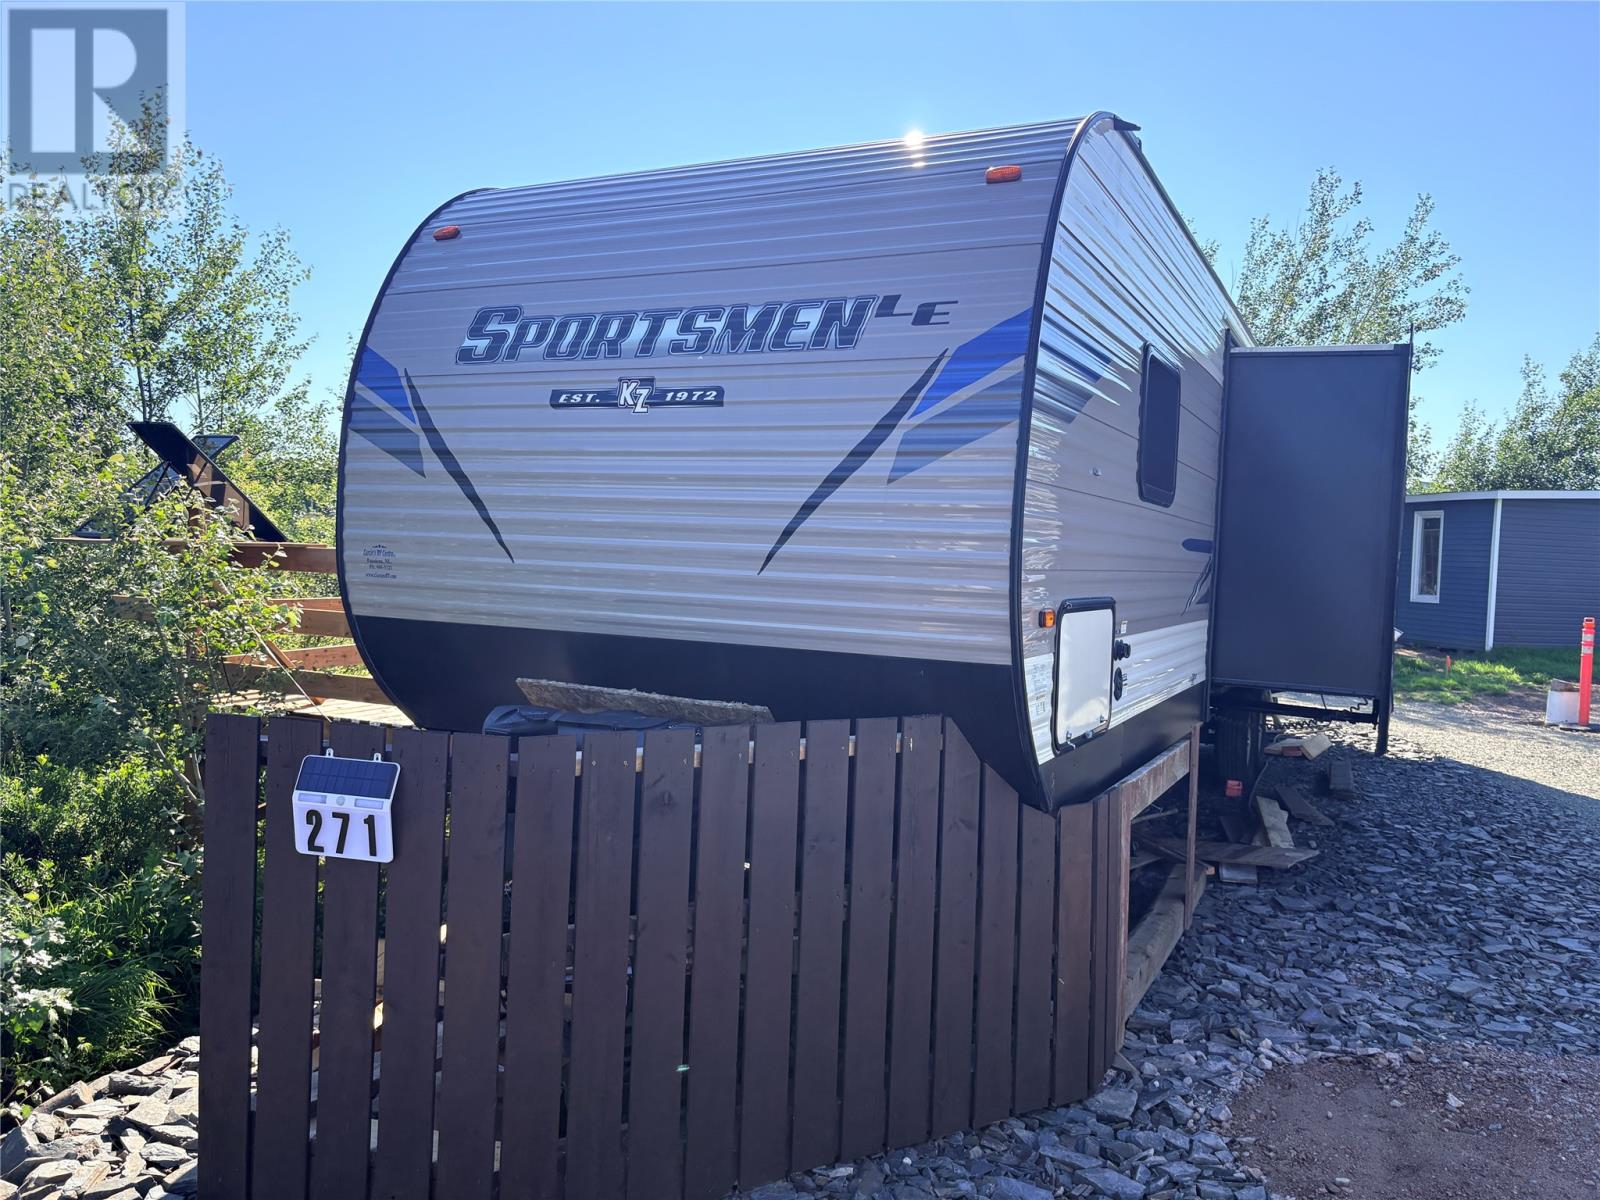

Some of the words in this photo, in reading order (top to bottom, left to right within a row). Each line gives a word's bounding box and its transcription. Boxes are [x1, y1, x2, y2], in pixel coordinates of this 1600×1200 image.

[456, 295, 878, 364] SPORTSMEN
[874, 294, 958, 326] LE
[558, 392, 600, 404] EST.
[619, 380, 650, 414] KZ
[664, 390, 718, 404] 1972
[306, 809, 377, 857] 271
